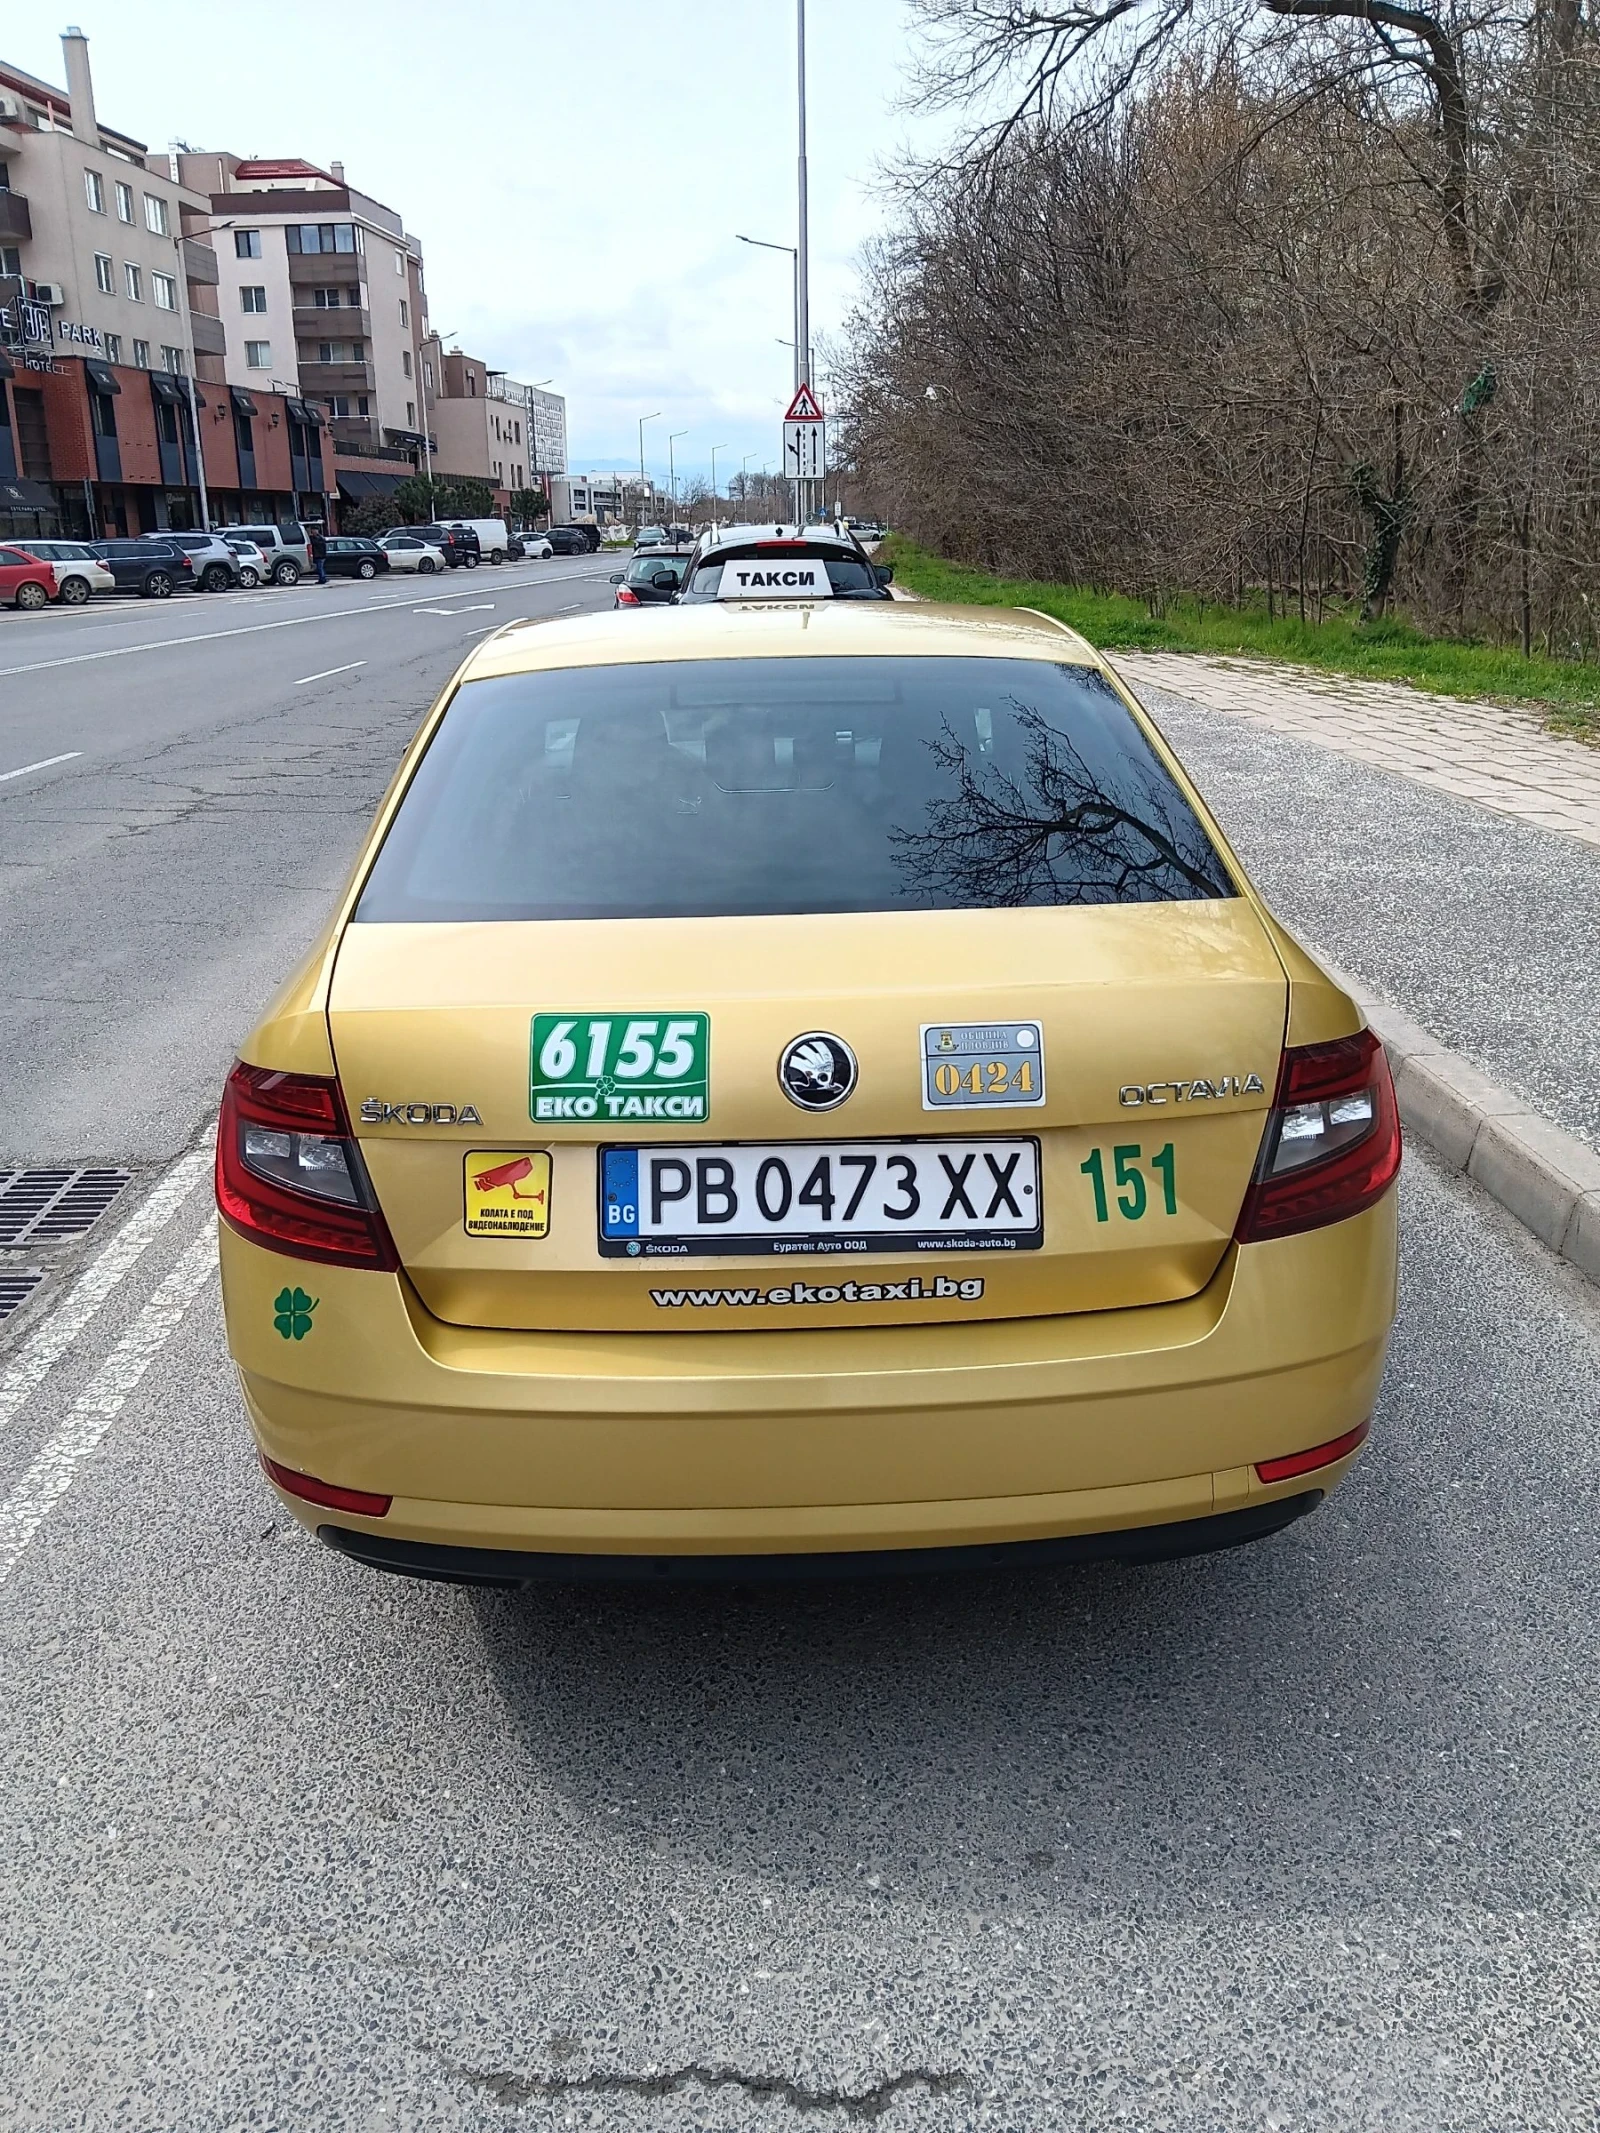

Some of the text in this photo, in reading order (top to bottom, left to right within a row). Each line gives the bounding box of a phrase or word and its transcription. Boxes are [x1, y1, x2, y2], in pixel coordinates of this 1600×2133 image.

[59, 321, 103, 347] PARK
[25, 359, 58, 374] HOTEL
[736, 571, 815, 587] ТАКСИ
[960, 1030, 1009, 1040] ОБЩИНА
[539, 1020, 699, 1079] 6155
[935, 1061, 1035, 1096] 0424
[1119, 1073, 1265, 1107] OCTAVIA
[360, 1096, 484, 1126] ŠKODA
[535, 1095, 705, 1118] ЕКО ТАКСИ
[650, 1153, 1024, 1224] PB 0473 XX
[1080, 1143, 1177, 1222] 151
[480, 1208, 534, 1220] КОЛАТА Е ПОД
[608, 1204, 636, 1224] BG
[468, 1220, 545, 1232] ВИДЕОНАБЛЮДЕНИЕ
[645, 1244, 689, 1254] ŠKODA
[773, 1240, 868, 1252] Еуратек Ауто ООД
[917, 1238, 1017, 1250] www.skoda-auto.bg
[650, 1276, 985, 1307] www.ekotaxi.bg
